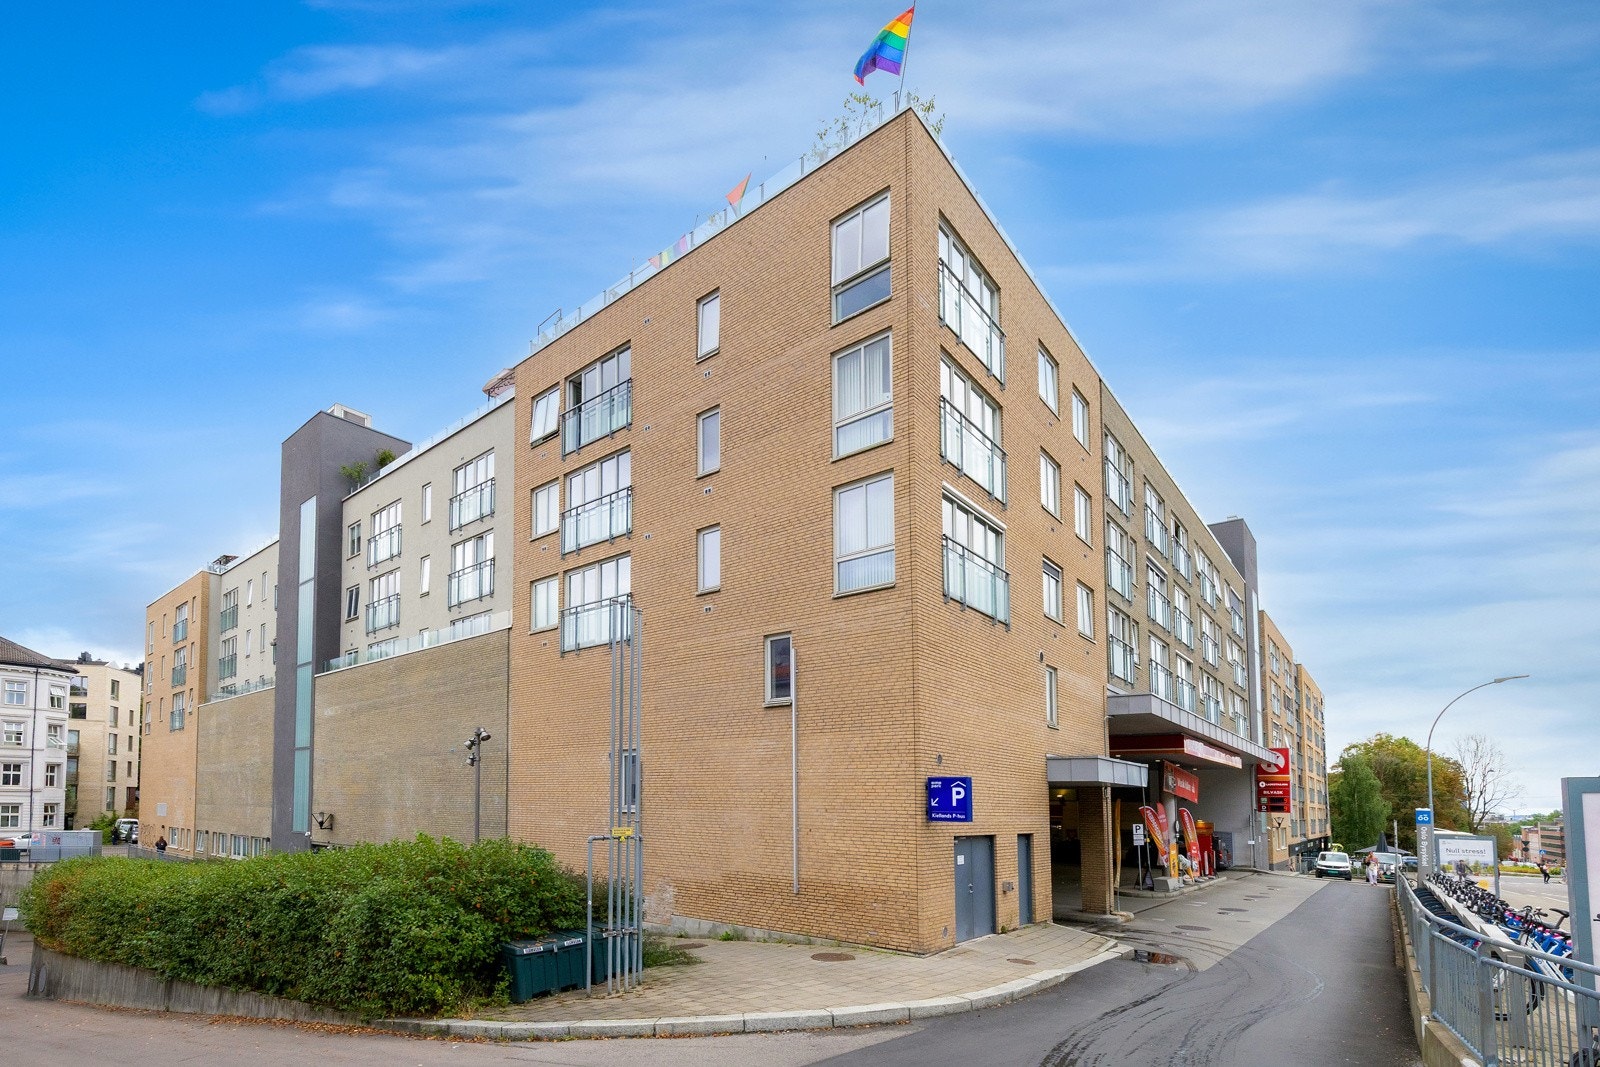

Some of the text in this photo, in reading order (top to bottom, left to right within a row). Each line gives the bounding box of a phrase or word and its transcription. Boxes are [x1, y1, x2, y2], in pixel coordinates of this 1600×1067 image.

[952, 787, 965, 806] P
[1135, 825, 1141, 833] P
[1420, 826, 1428, 840] Oslo
